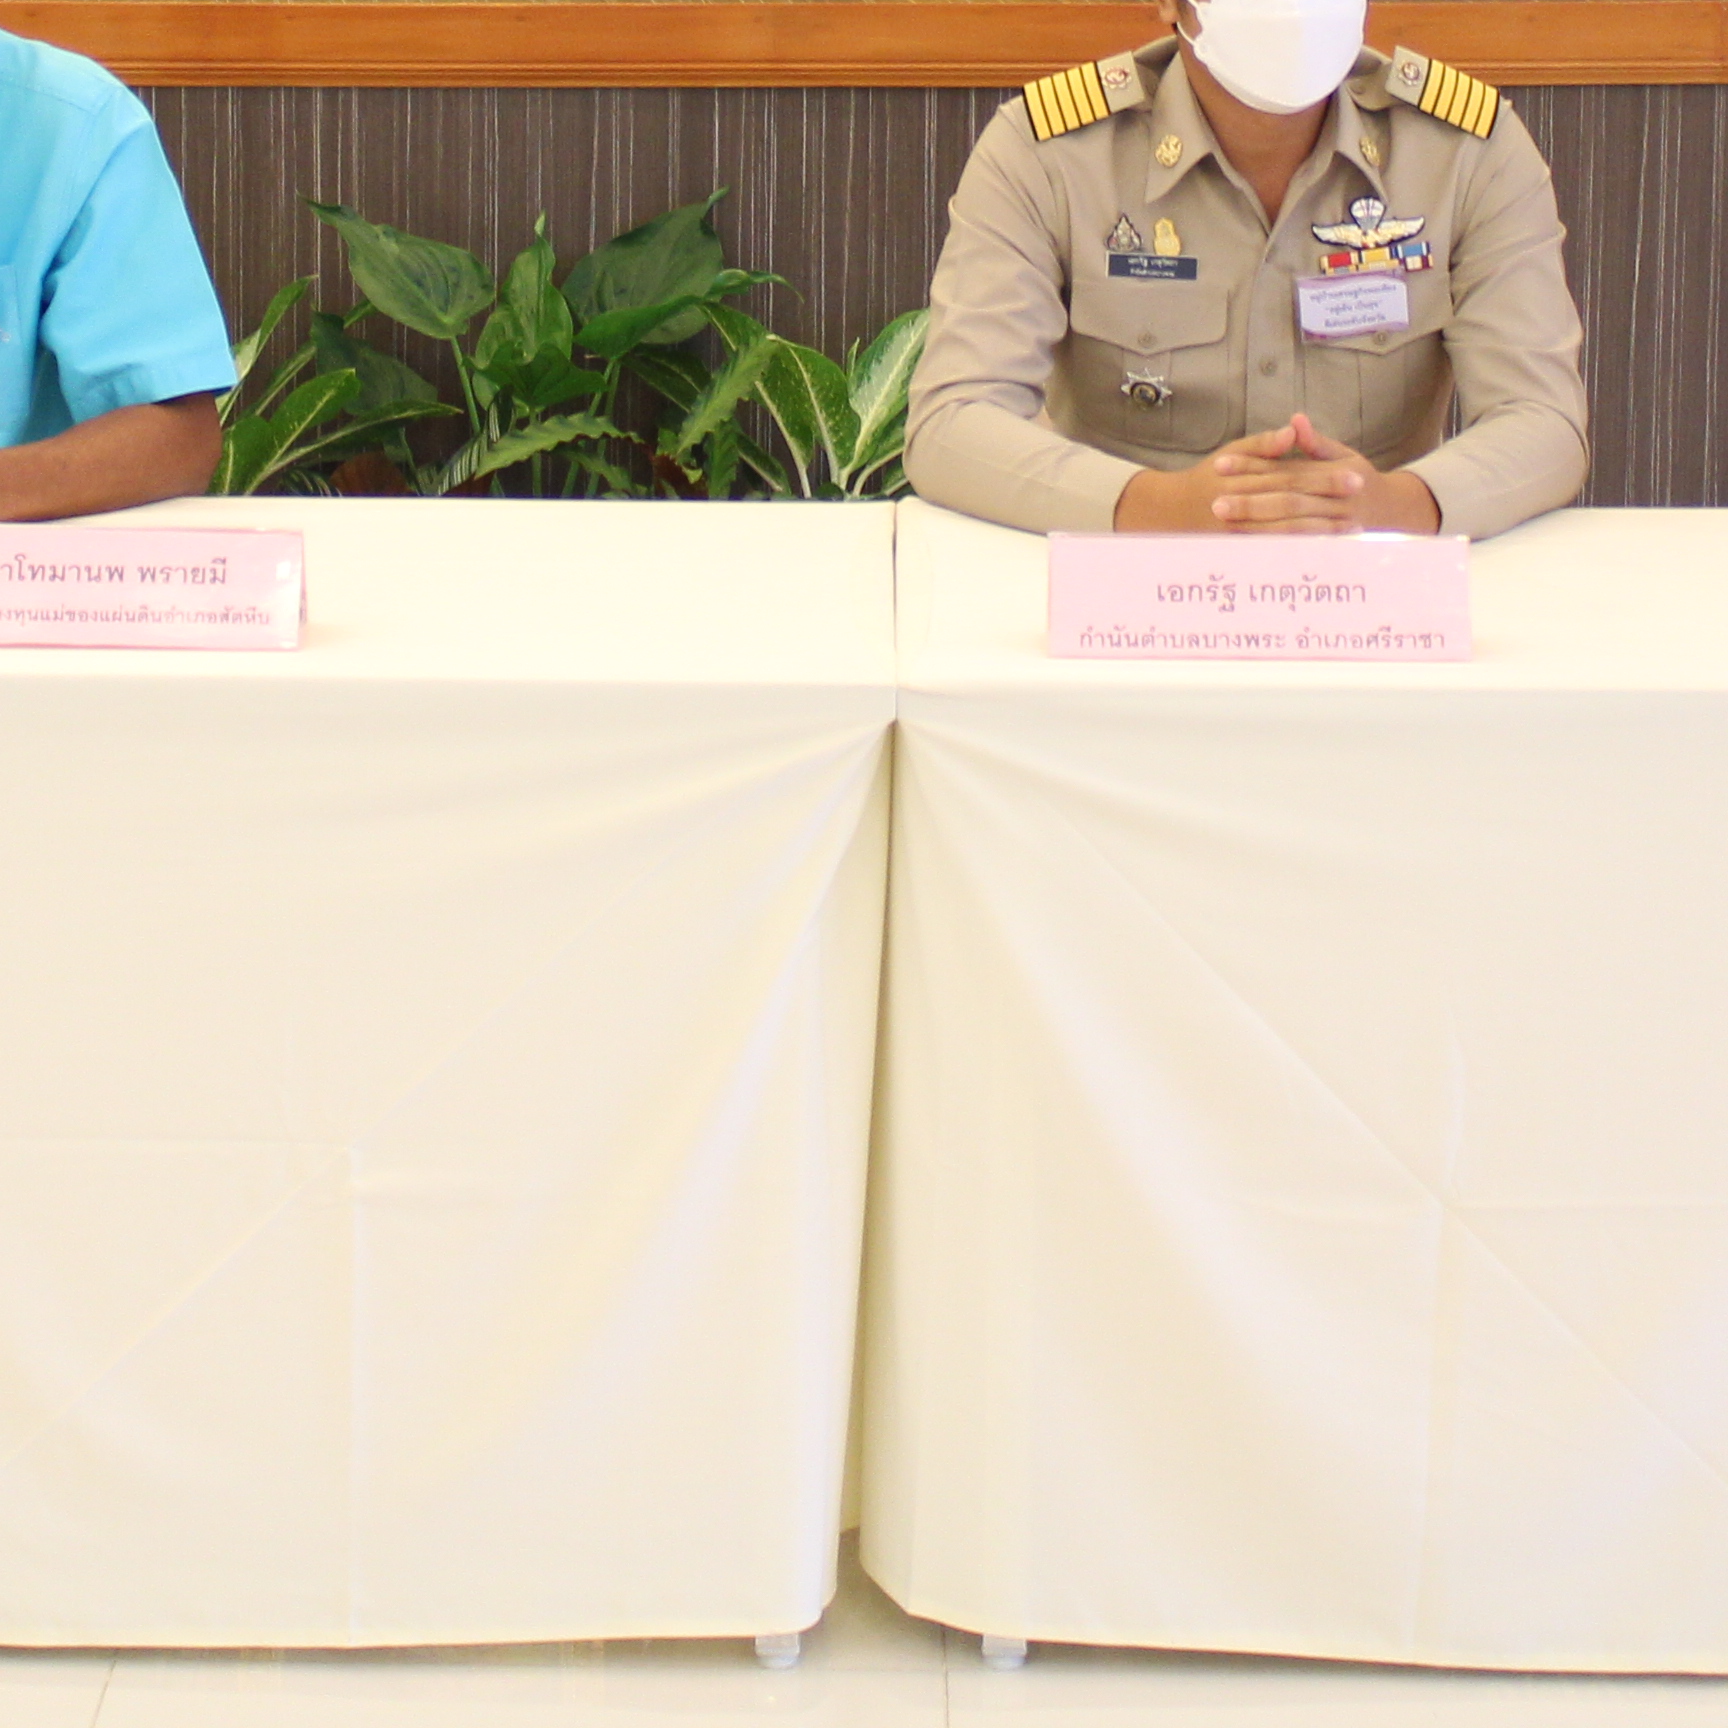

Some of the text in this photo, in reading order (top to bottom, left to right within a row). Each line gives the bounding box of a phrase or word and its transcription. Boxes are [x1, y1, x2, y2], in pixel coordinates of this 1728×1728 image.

[136, 556, 228, 586] พรายมี
[1156, 573, 1367, 614] เอกรัฐ เกตุวัตถา
[1079, 623, 1446, 651] กำนันตำบลบางพระ อำเภอศรีราชา
